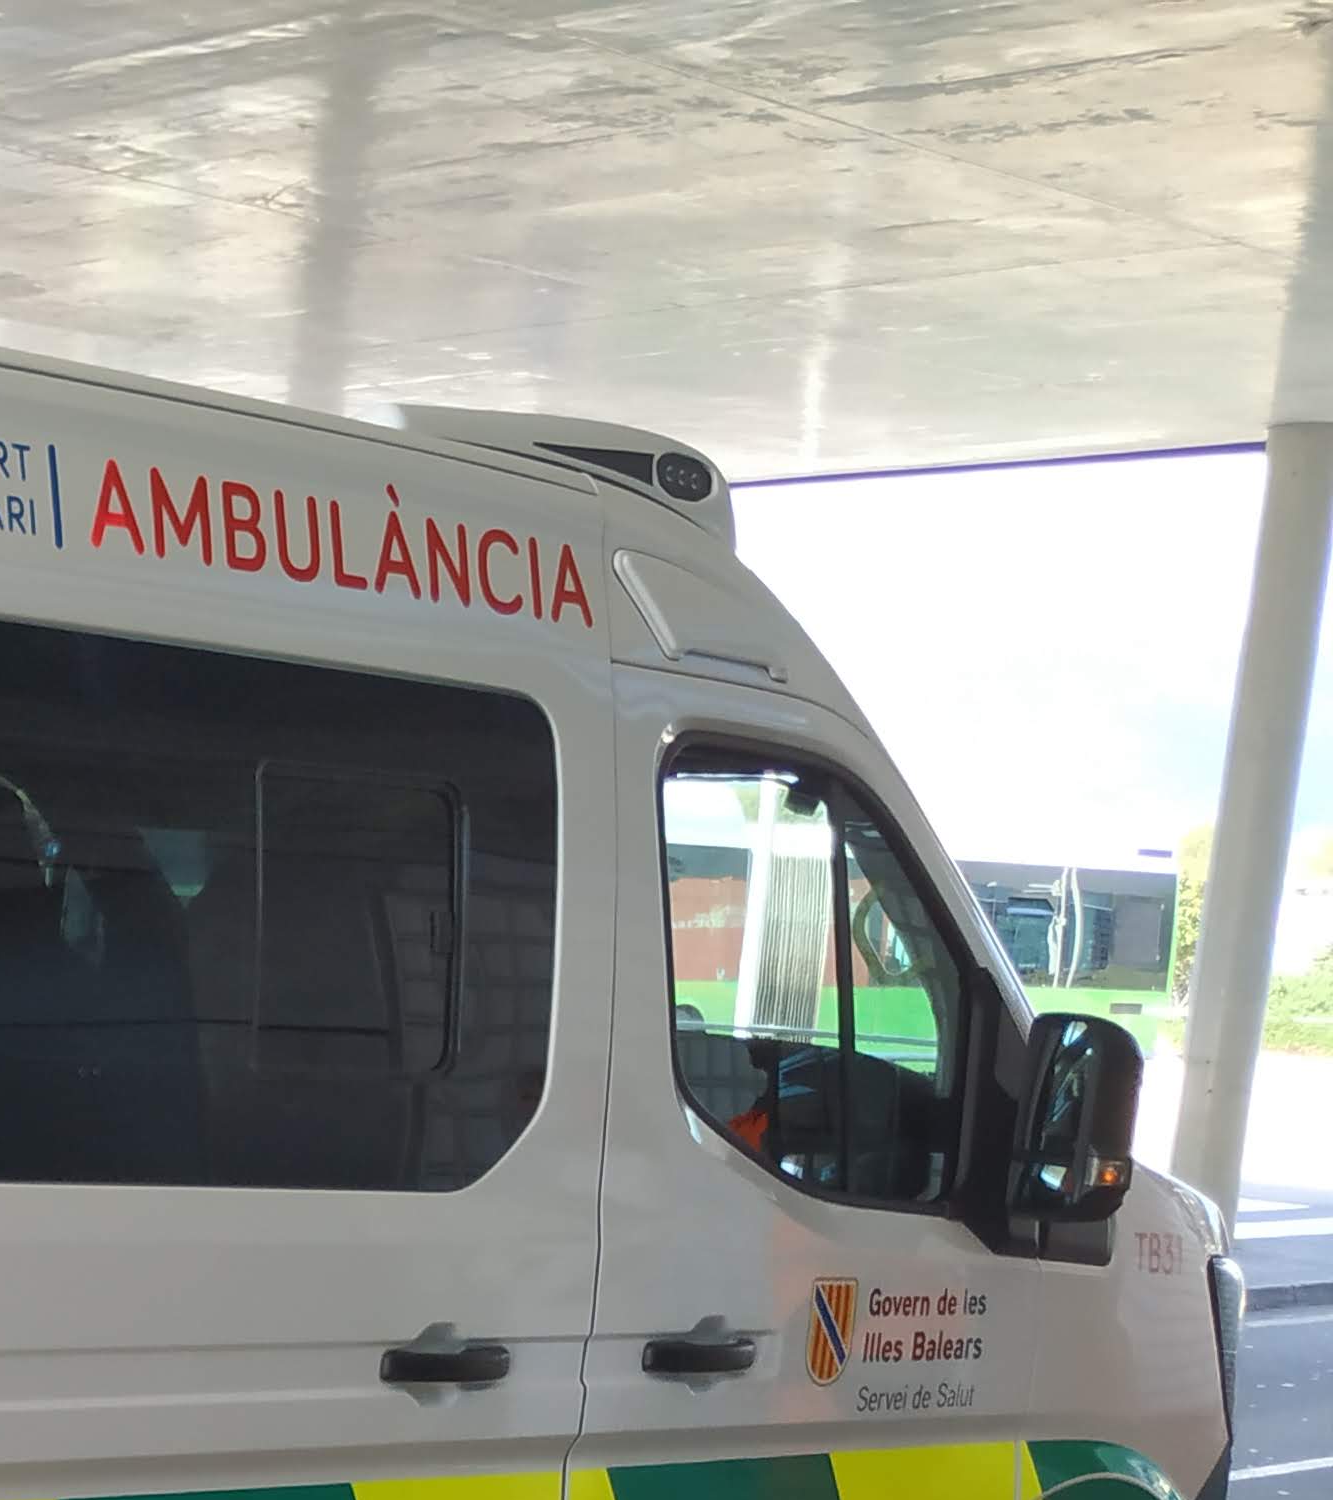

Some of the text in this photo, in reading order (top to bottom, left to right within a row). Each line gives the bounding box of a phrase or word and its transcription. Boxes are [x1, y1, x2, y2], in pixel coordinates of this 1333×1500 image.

[89, 457, 594, 628] AMBULÀNCIA
[868, 1287, 987, 1317] Govern de les
[861, 1329, 983, 1364] Illes Balears
[856, 1381, 976, 1413] Servei de Salut
